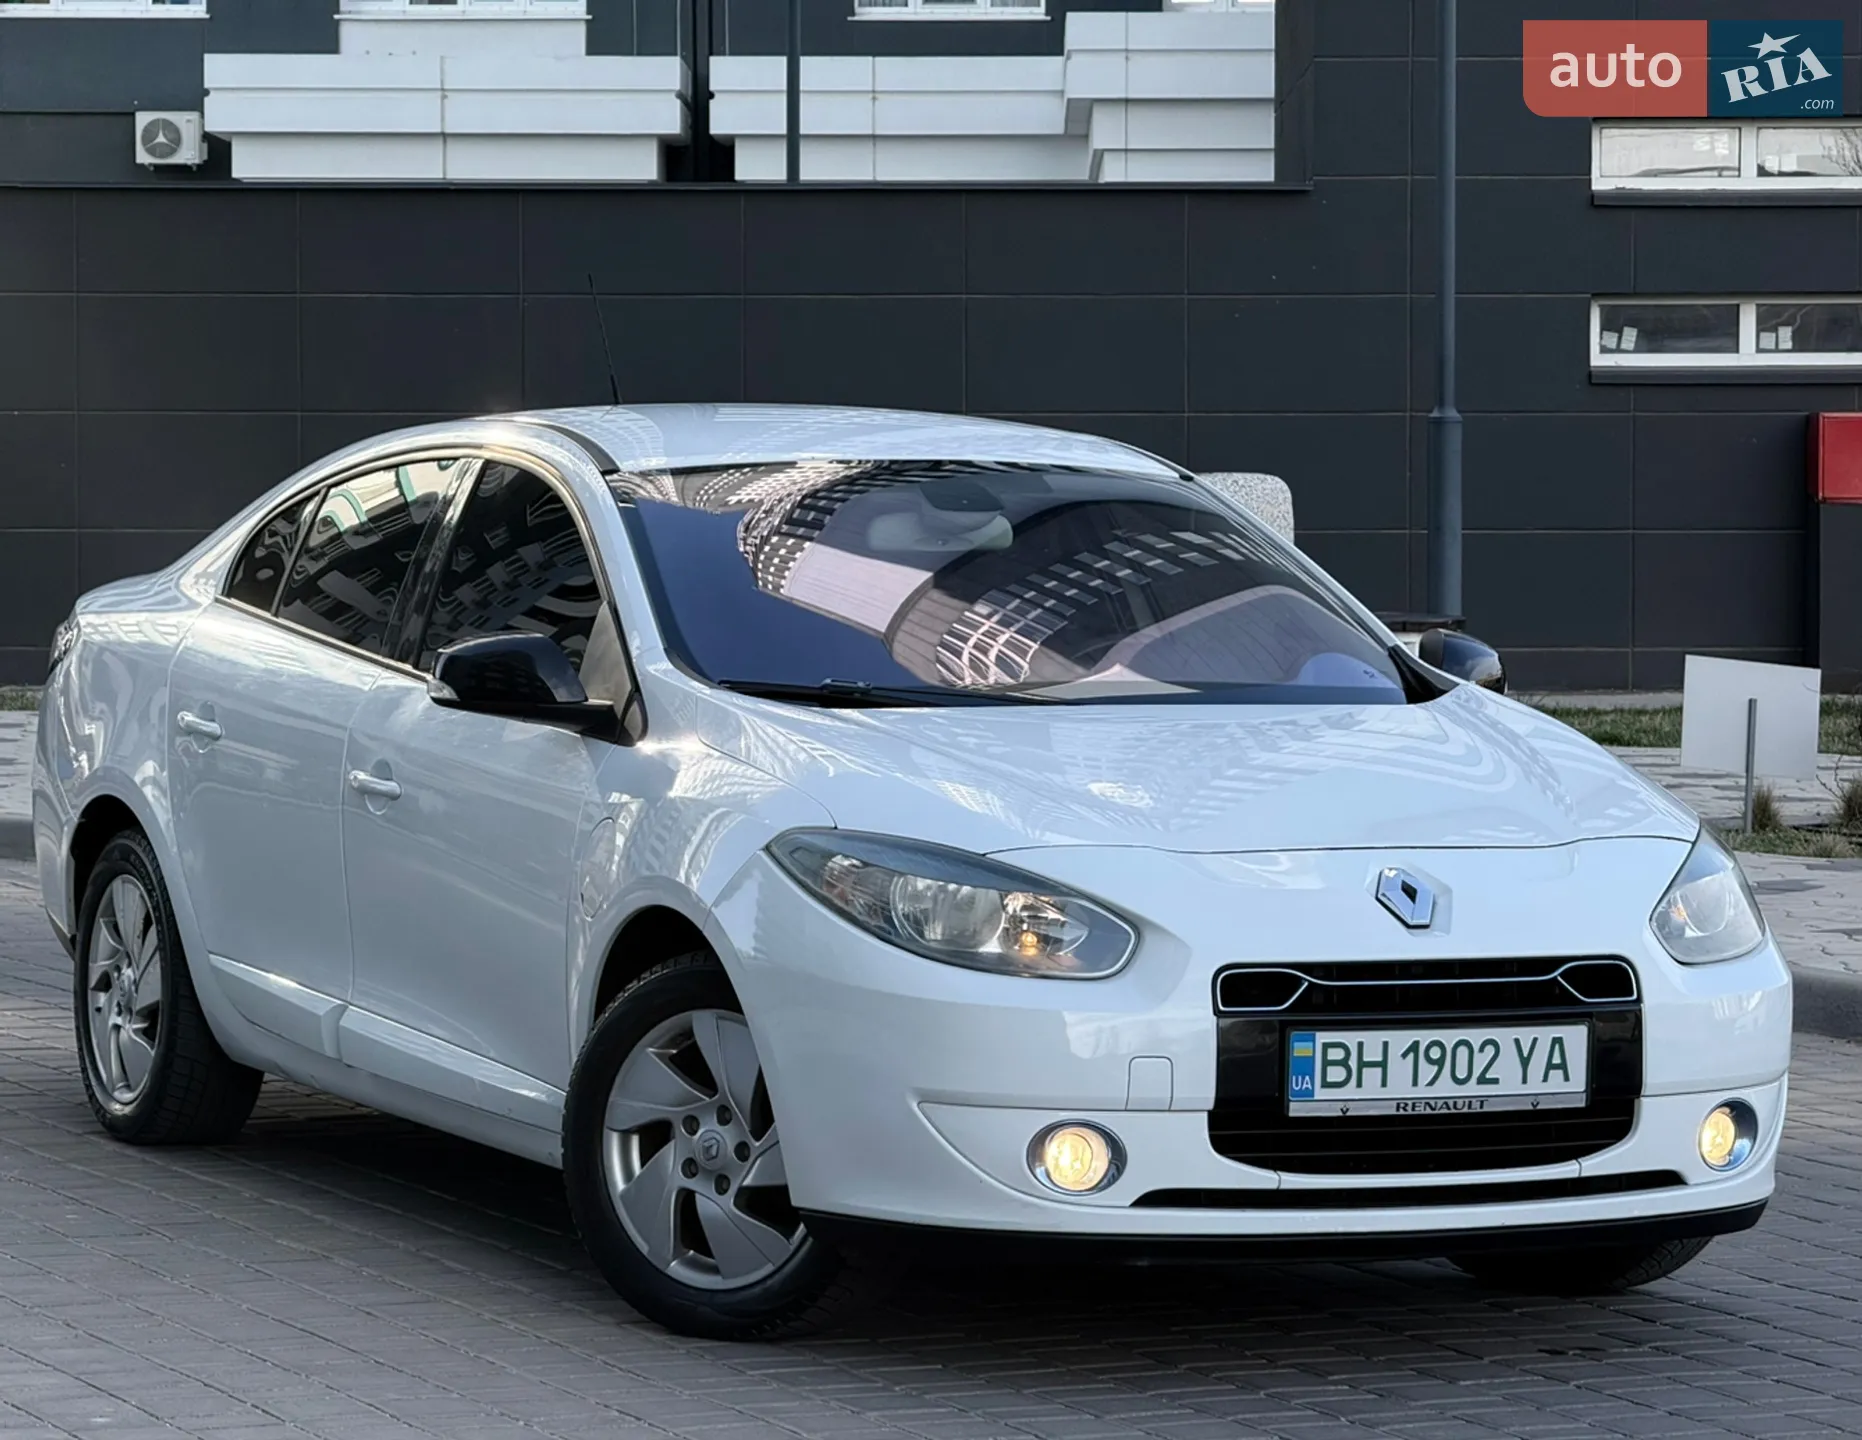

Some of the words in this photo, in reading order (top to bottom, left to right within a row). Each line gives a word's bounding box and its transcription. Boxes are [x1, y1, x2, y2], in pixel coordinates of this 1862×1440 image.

[1320, 1040, 1390, 1089] BH
[1400, 1037, 1501, 1087] 1902
[1514, 1036, 1571, 1084] YA
[1292, 1075, 1312, 1091] UA
[1395, 1099, 1489, 1113] RENAULT
